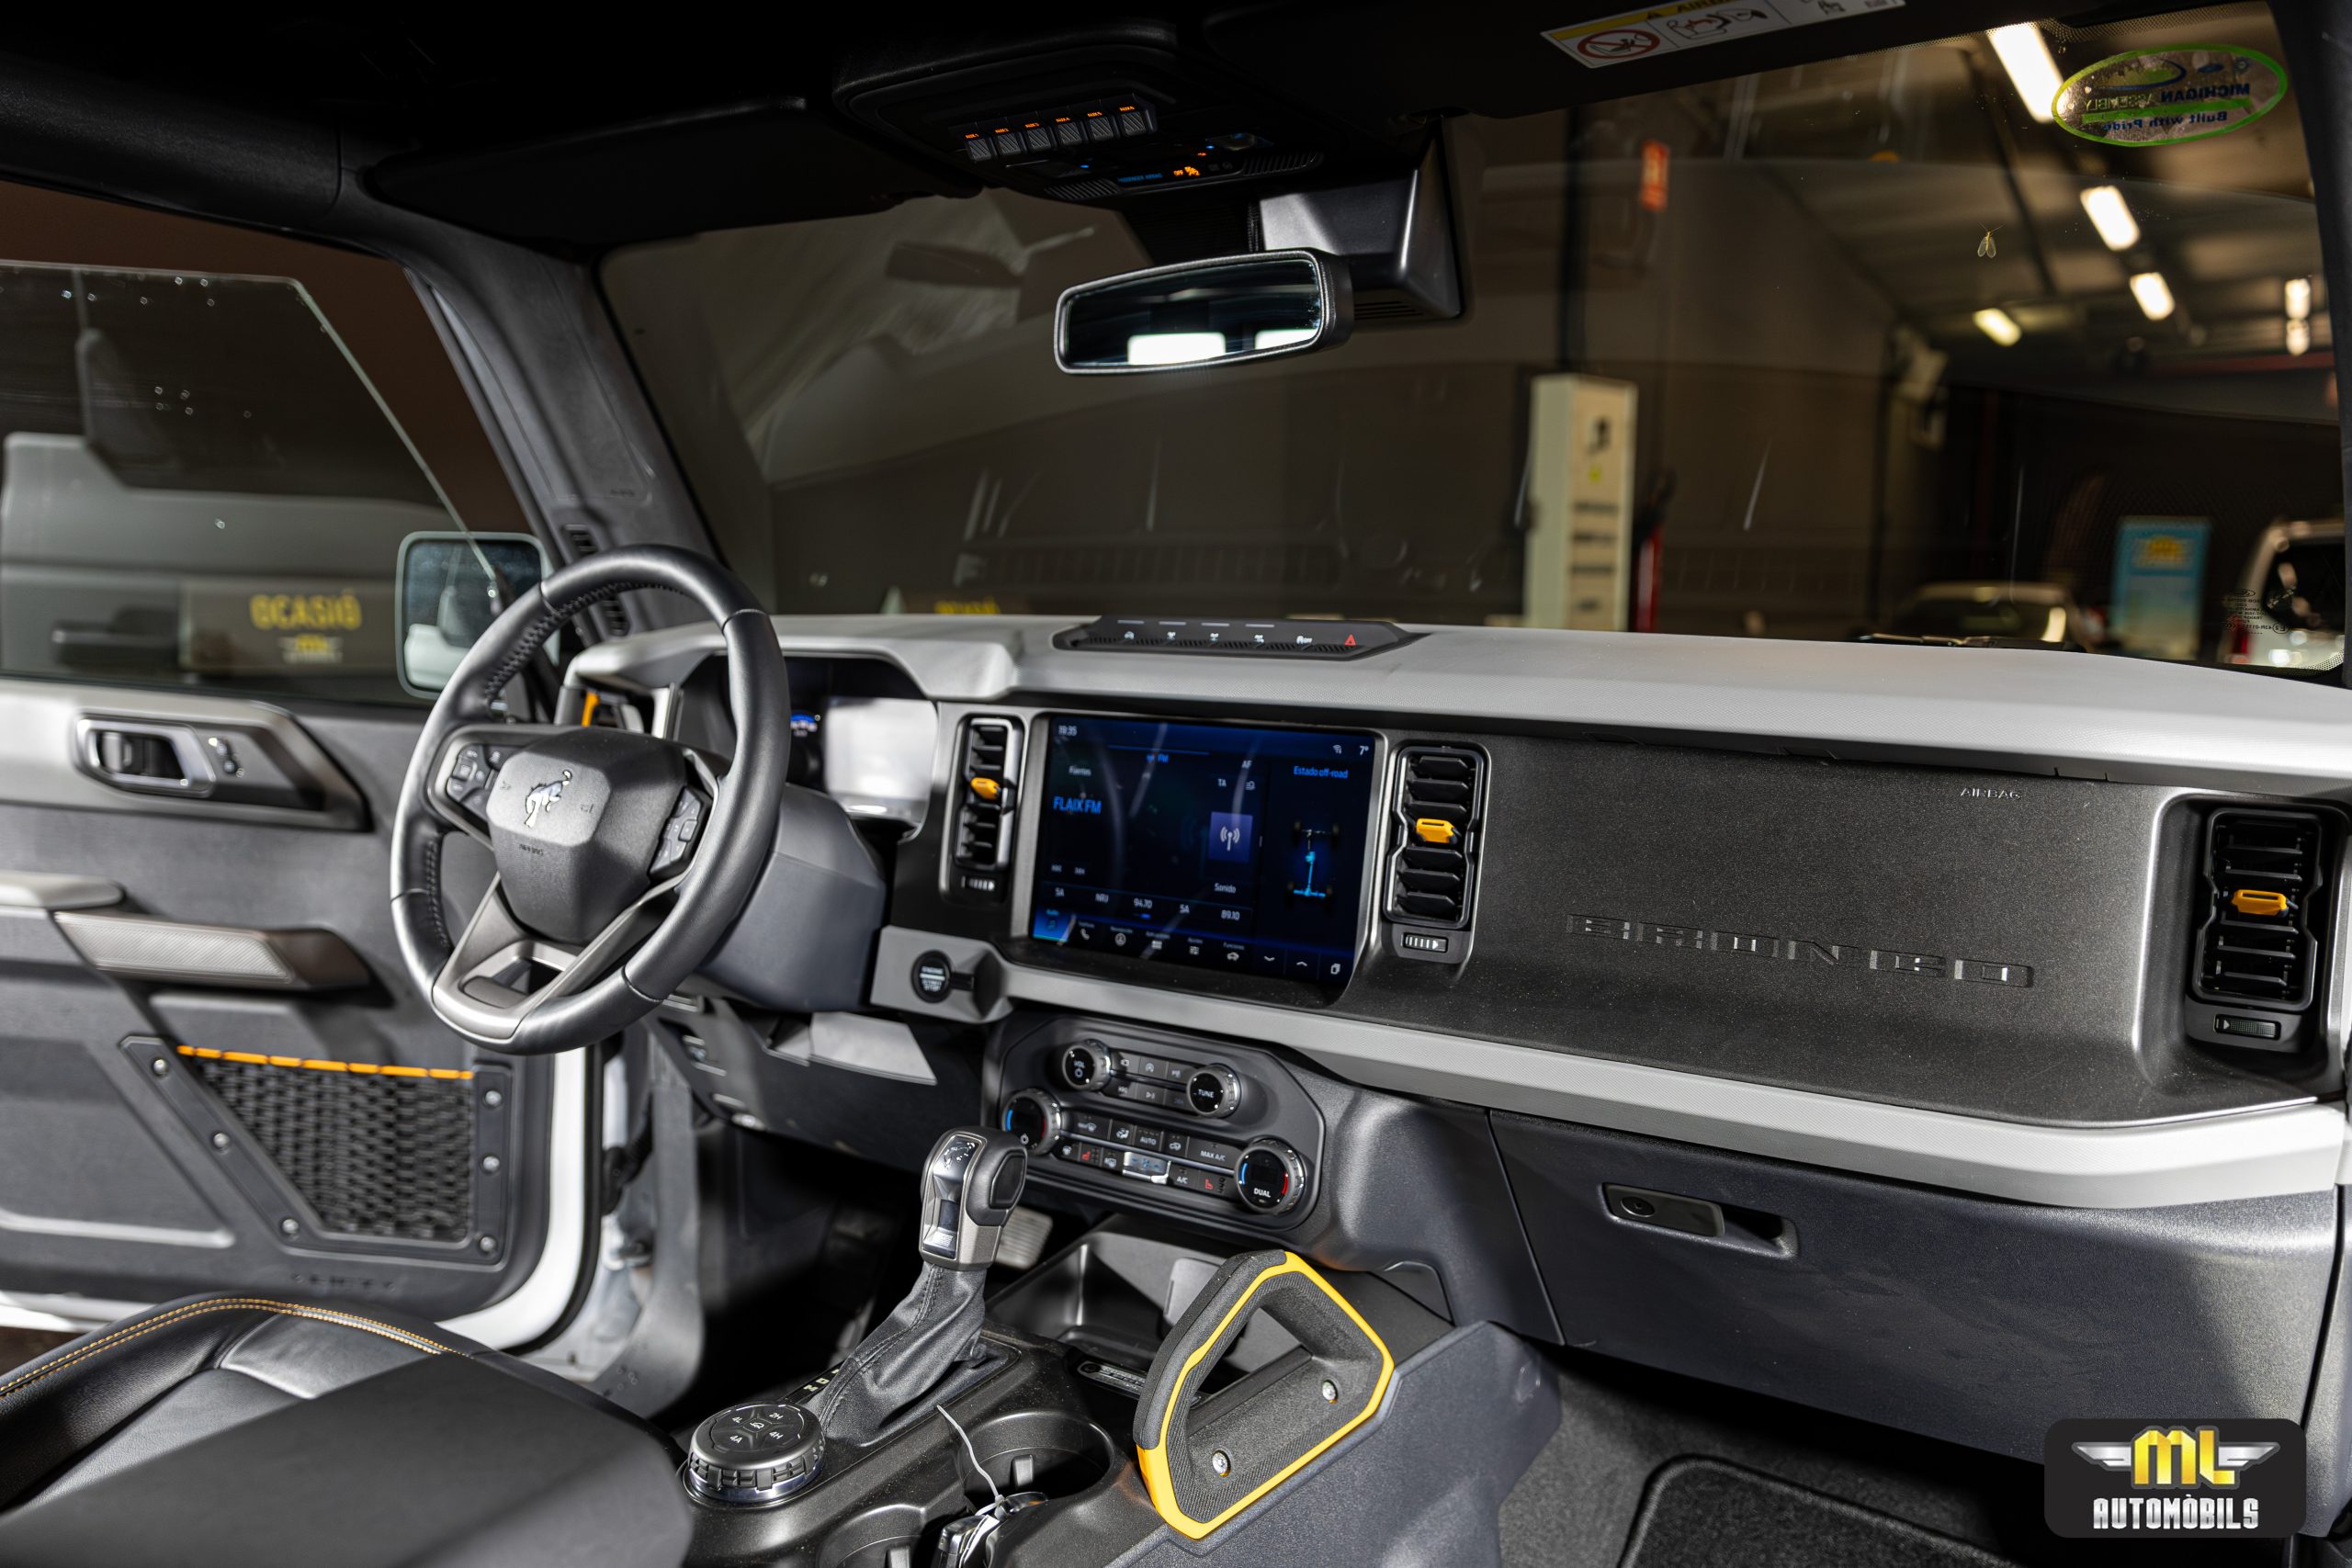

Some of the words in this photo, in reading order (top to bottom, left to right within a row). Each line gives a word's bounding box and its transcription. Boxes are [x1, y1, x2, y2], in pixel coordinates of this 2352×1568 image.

[1960, 787, 2021, 799] AIRBAG
[1053, 795, 1084, 812] FLAIX
[1084, 800, 1102, 815] FM
[1214, 882, 1237, 894] Sonido
[1566, 914, 2035, 989] BRONCO
[1073, 1060, 1086, 1069] VOL
[1197, 1089, 1215, 1099] TUNE
[1139, 1136, 1157, 1145] AUTO
[1200, 1150, 1215, 1159] MAX
[1177, 1176, 1188, 1184] A/C
[1253, 1188, 1272, 1198] DUAL
[732, 1416, 742, 1424] 4L
[769, 1412, 784, 1420] 2H
[729, 1435, 742, 1444] 4A
[769, 1431, 784, 1439] 4H
